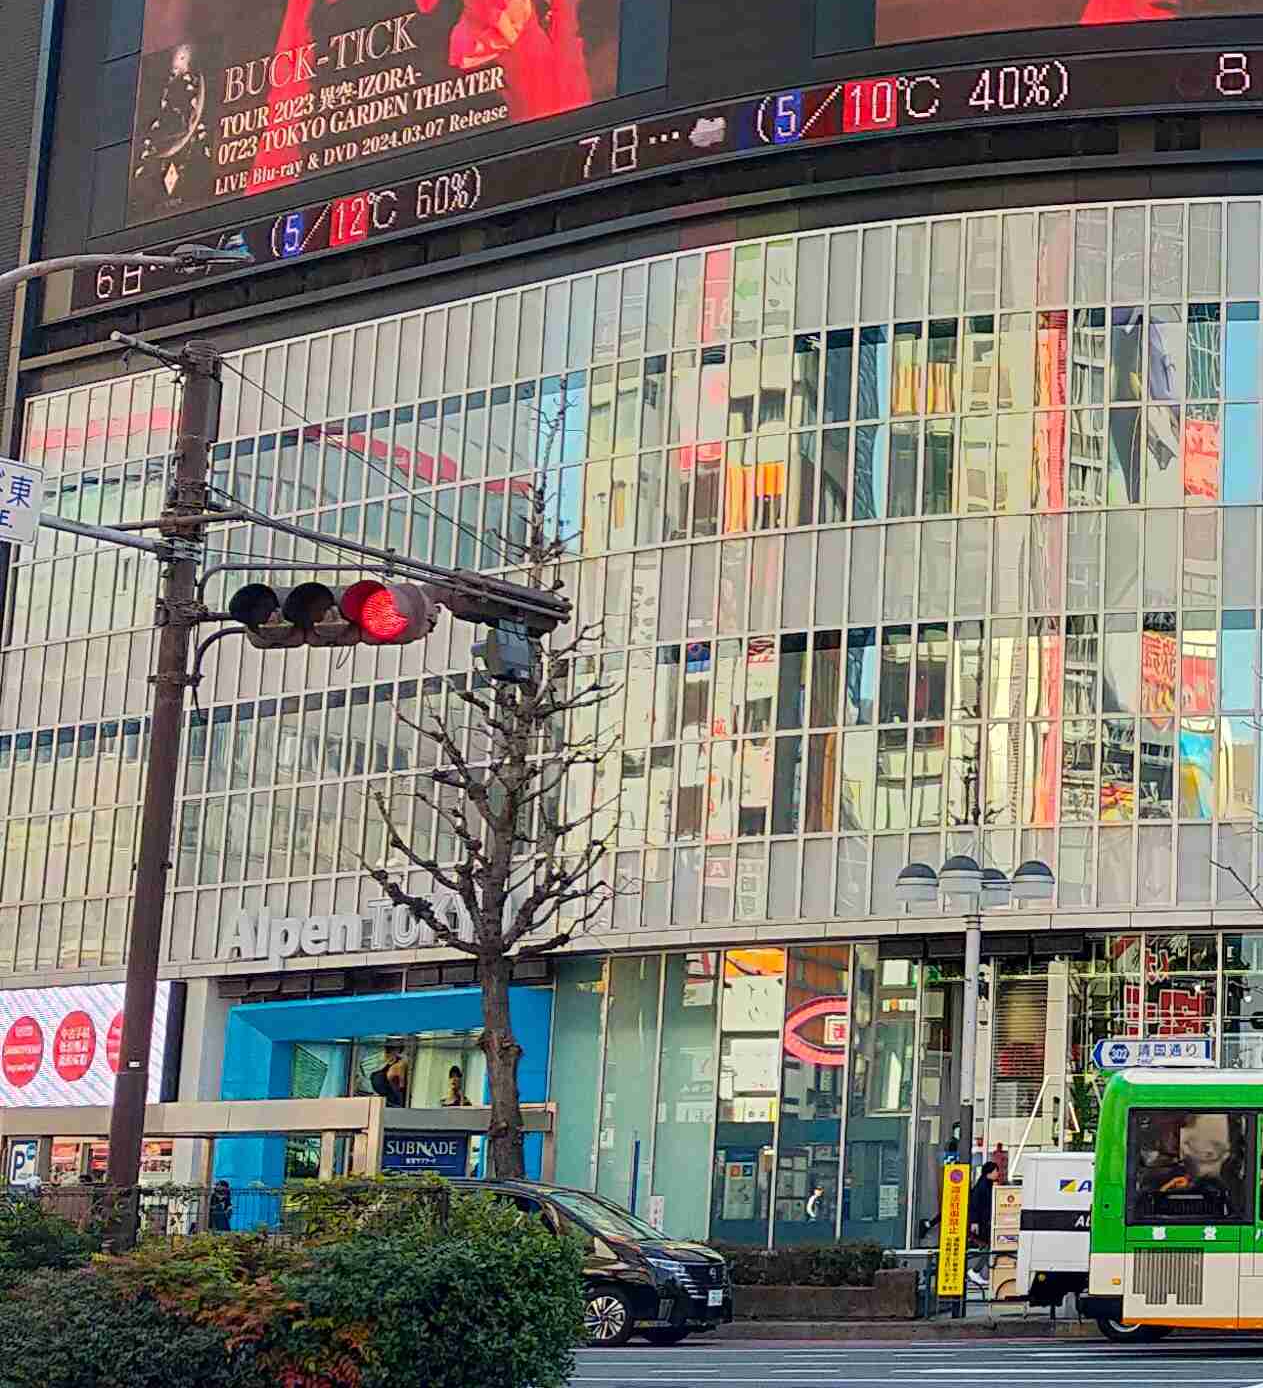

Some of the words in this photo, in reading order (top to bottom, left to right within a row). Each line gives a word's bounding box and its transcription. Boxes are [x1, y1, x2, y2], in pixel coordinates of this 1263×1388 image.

[222, 12, 418, 103] BUCK-TICK
[214, 172, 248, 196] LIVE
[251, 155, 303, 188] Blu-ray
[307, 152, 320, 172] &
[323, 143, 359, 170] DVD
[361, 118, 445, 158] 2024.03.07
[448, 104, 509, 133] Release
[218, 135, 258, 166] 0723
[261, 119, 327, 157] TOKYO
[329, 95, 411, 138] GARDEN
[412, 66, 505, 115] THEATER
[221, 107, 271, 140] TOUR
[274, 93, 315, 127] 2023
[222, 906, 360, 970] Alpen
[386, 1139, 457, 1157] SUBNADE
